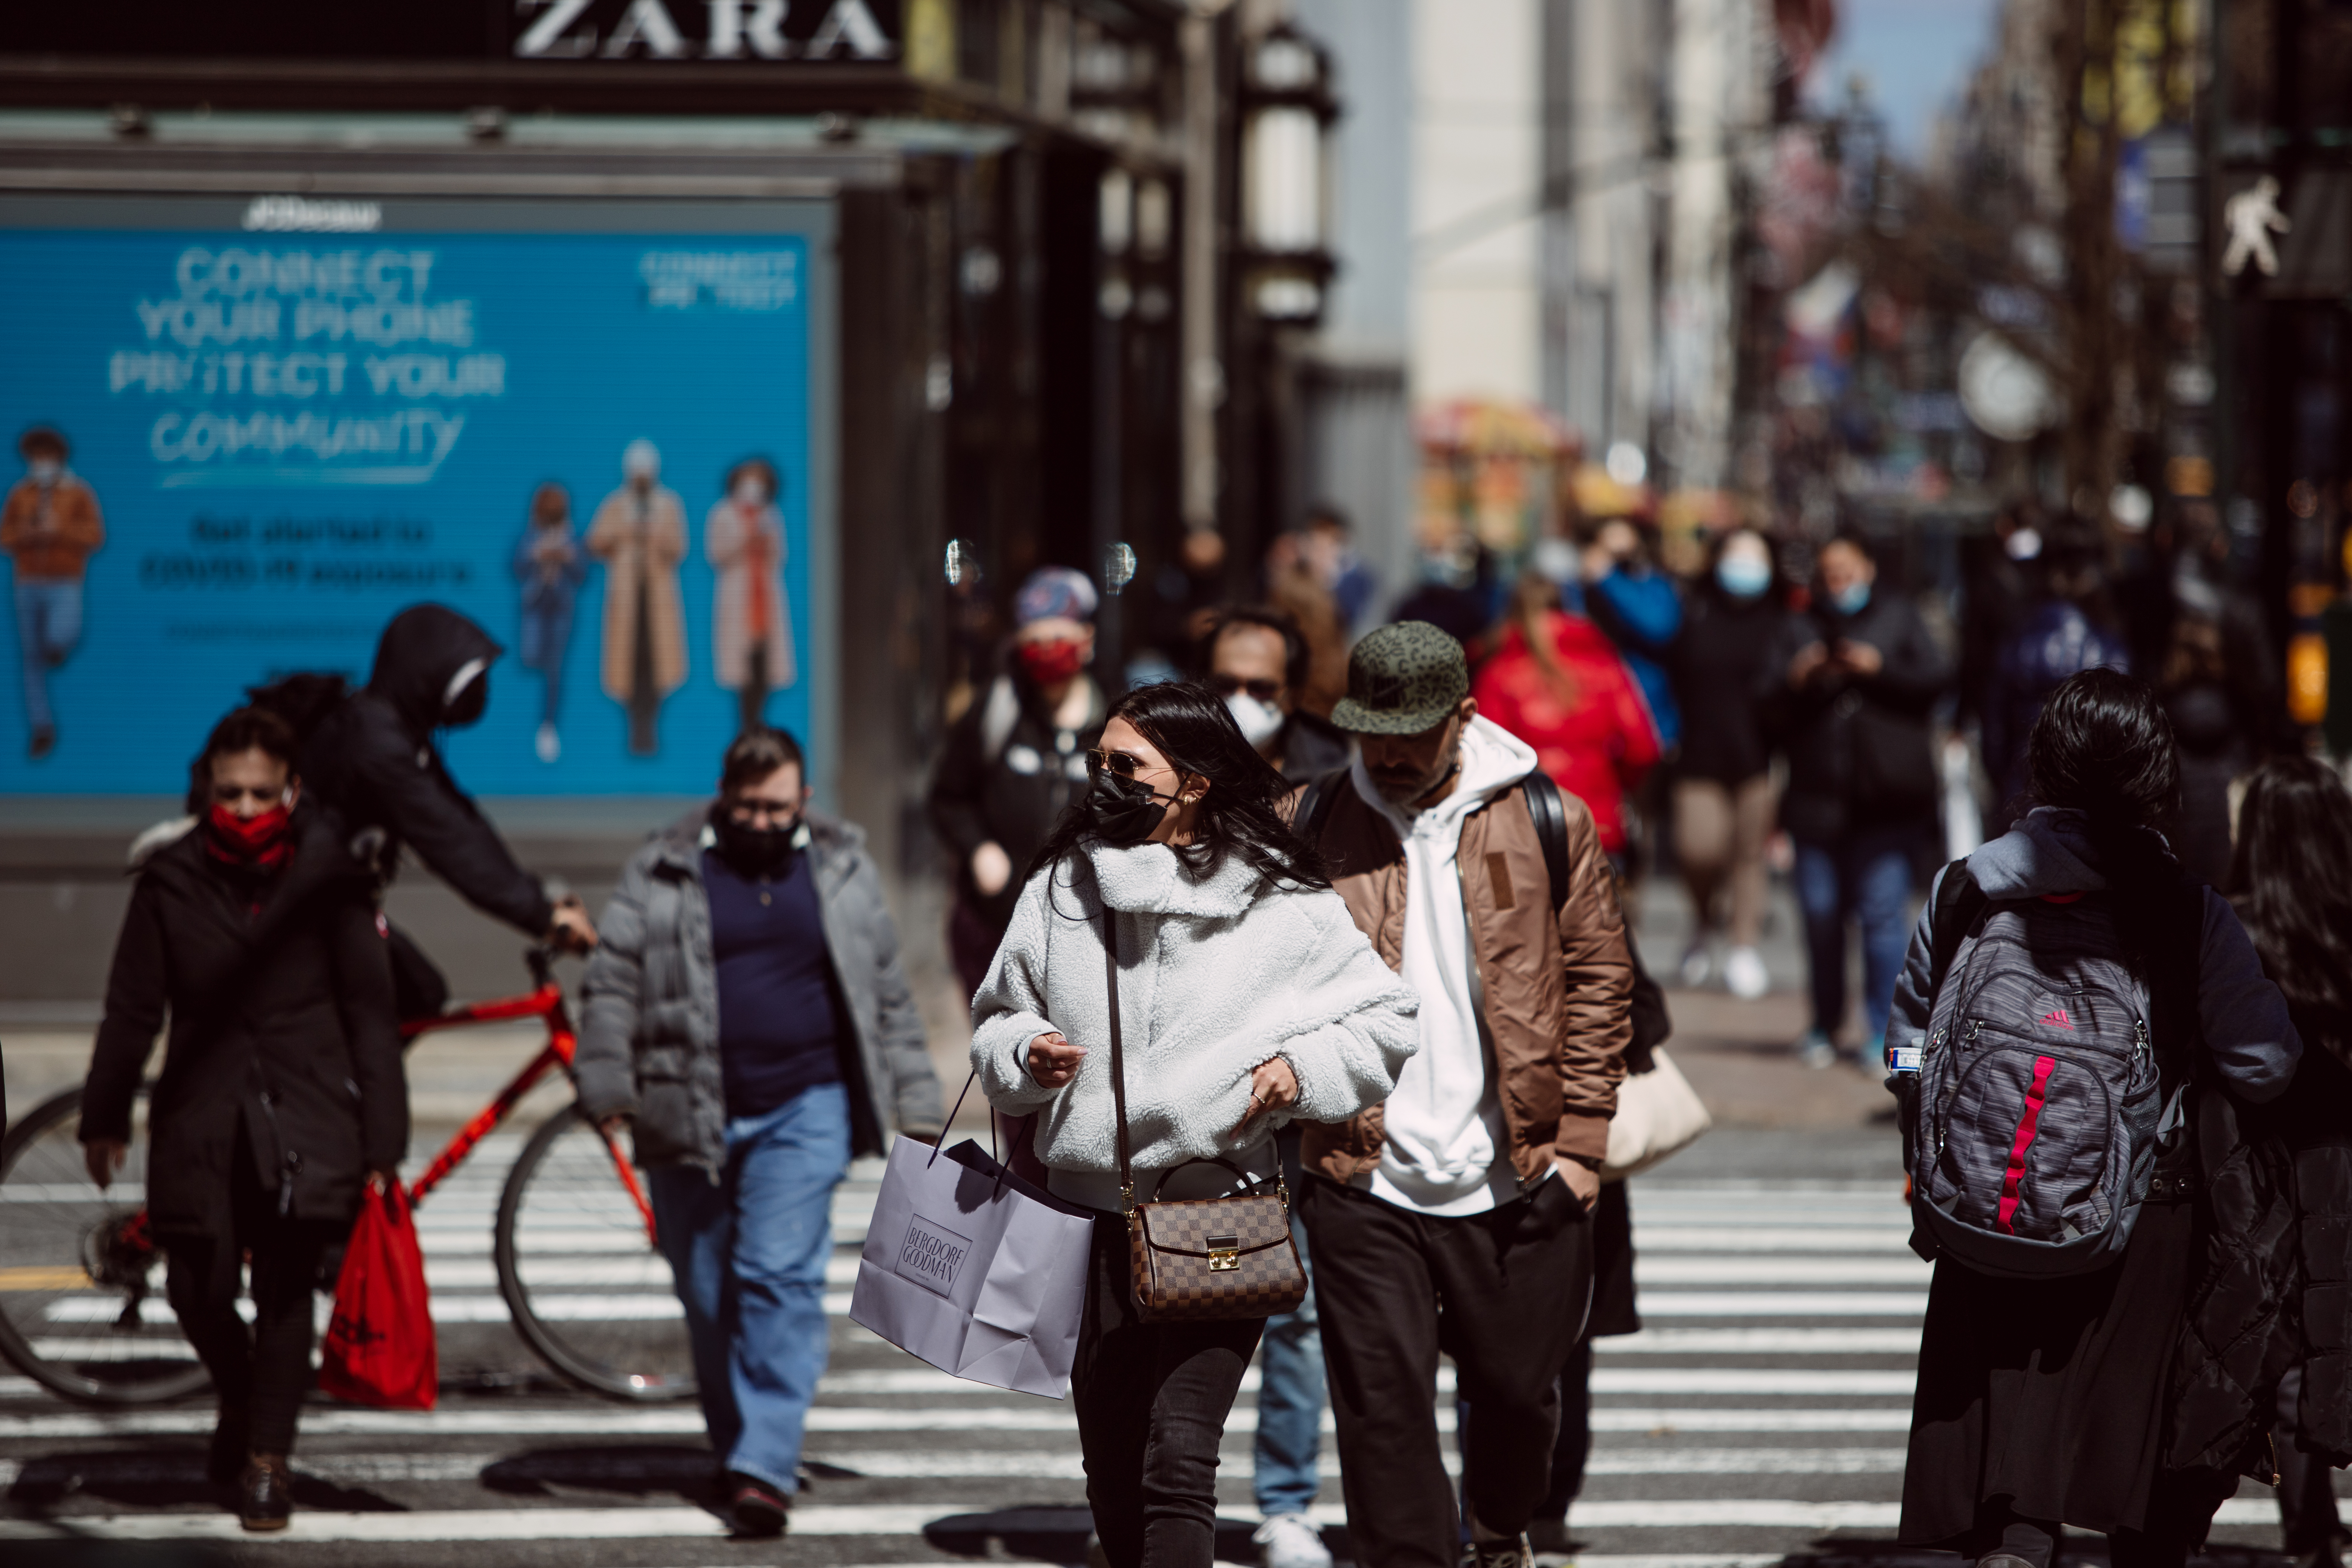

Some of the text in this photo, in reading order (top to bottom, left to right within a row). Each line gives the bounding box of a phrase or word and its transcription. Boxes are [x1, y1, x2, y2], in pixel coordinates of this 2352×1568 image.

[513, 0, 900, 60] ZARA
[176, 247, 435, 300] CONNECT
[137, 300, 474, 347] YOUR PHONE
[364, 352, 506, 397] YOUR
[150, 407, 466, 463] COMMUNITY
[2040, 1018, 2074, 1031] adidas
[903, 1246, 956, 1283] GOODMAN
[908, 1227, 964, 1266] BERGDORF
